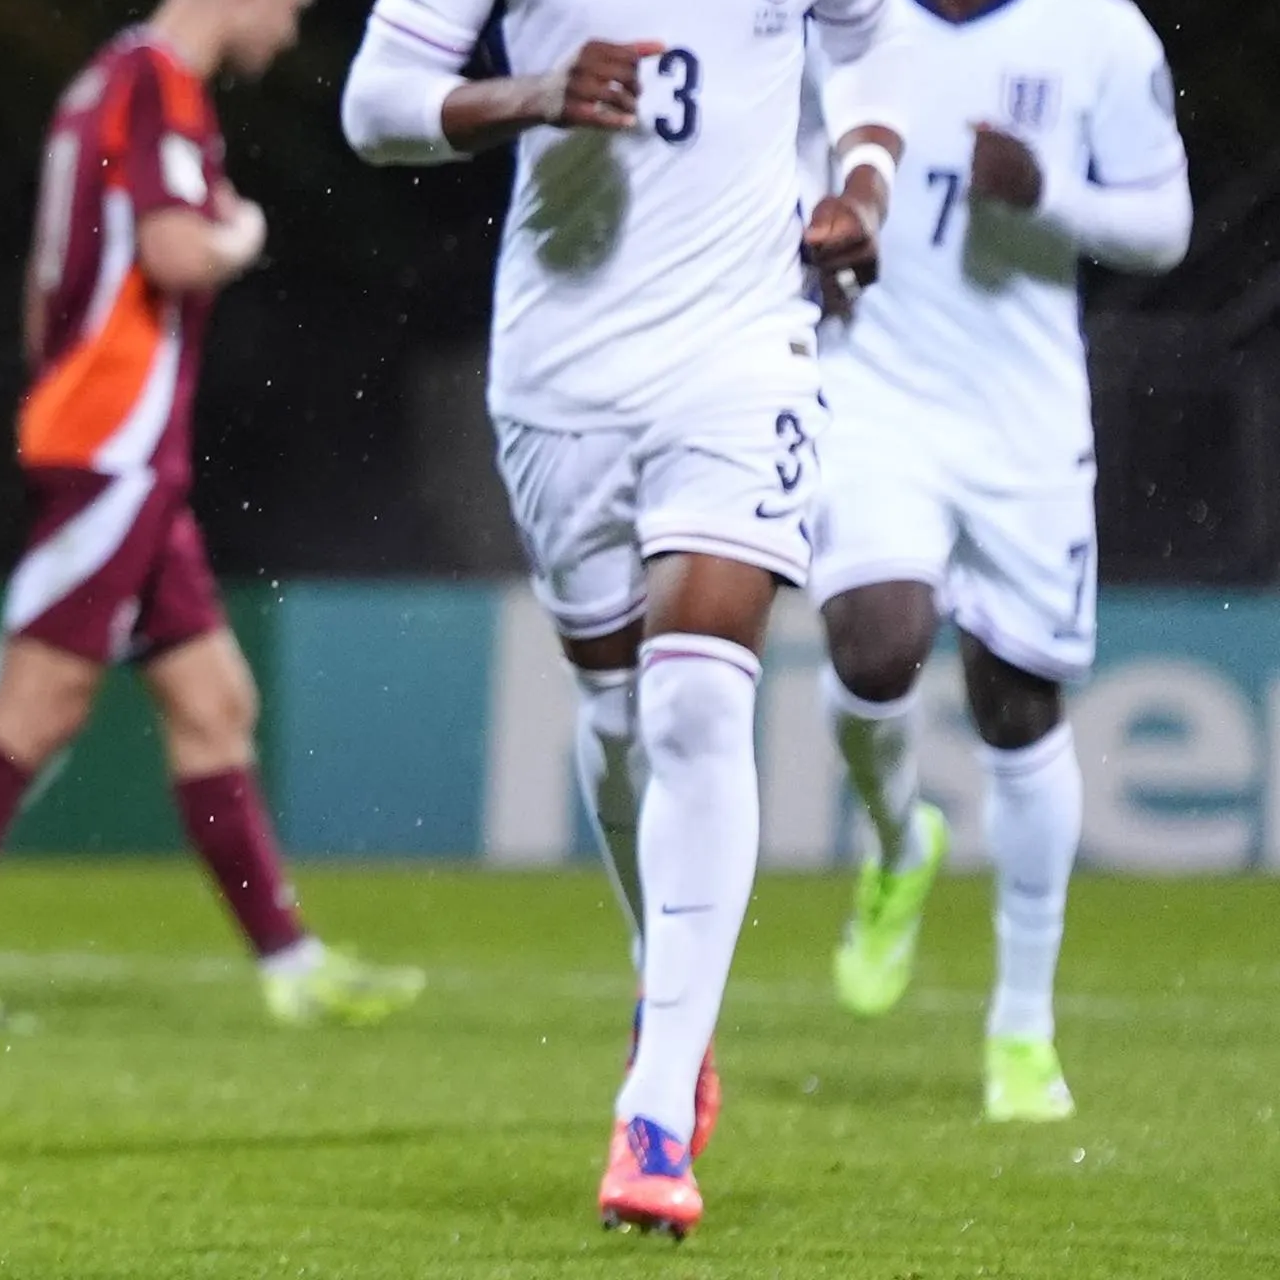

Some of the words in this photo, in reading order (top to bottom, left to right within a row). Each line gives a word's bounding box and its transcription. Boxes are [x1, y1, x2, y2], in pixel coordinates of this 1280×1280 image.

[654, 46, 702, 144] 3
[925, 169, 961, 246] 7
[775, 410, 807, 493] 3
